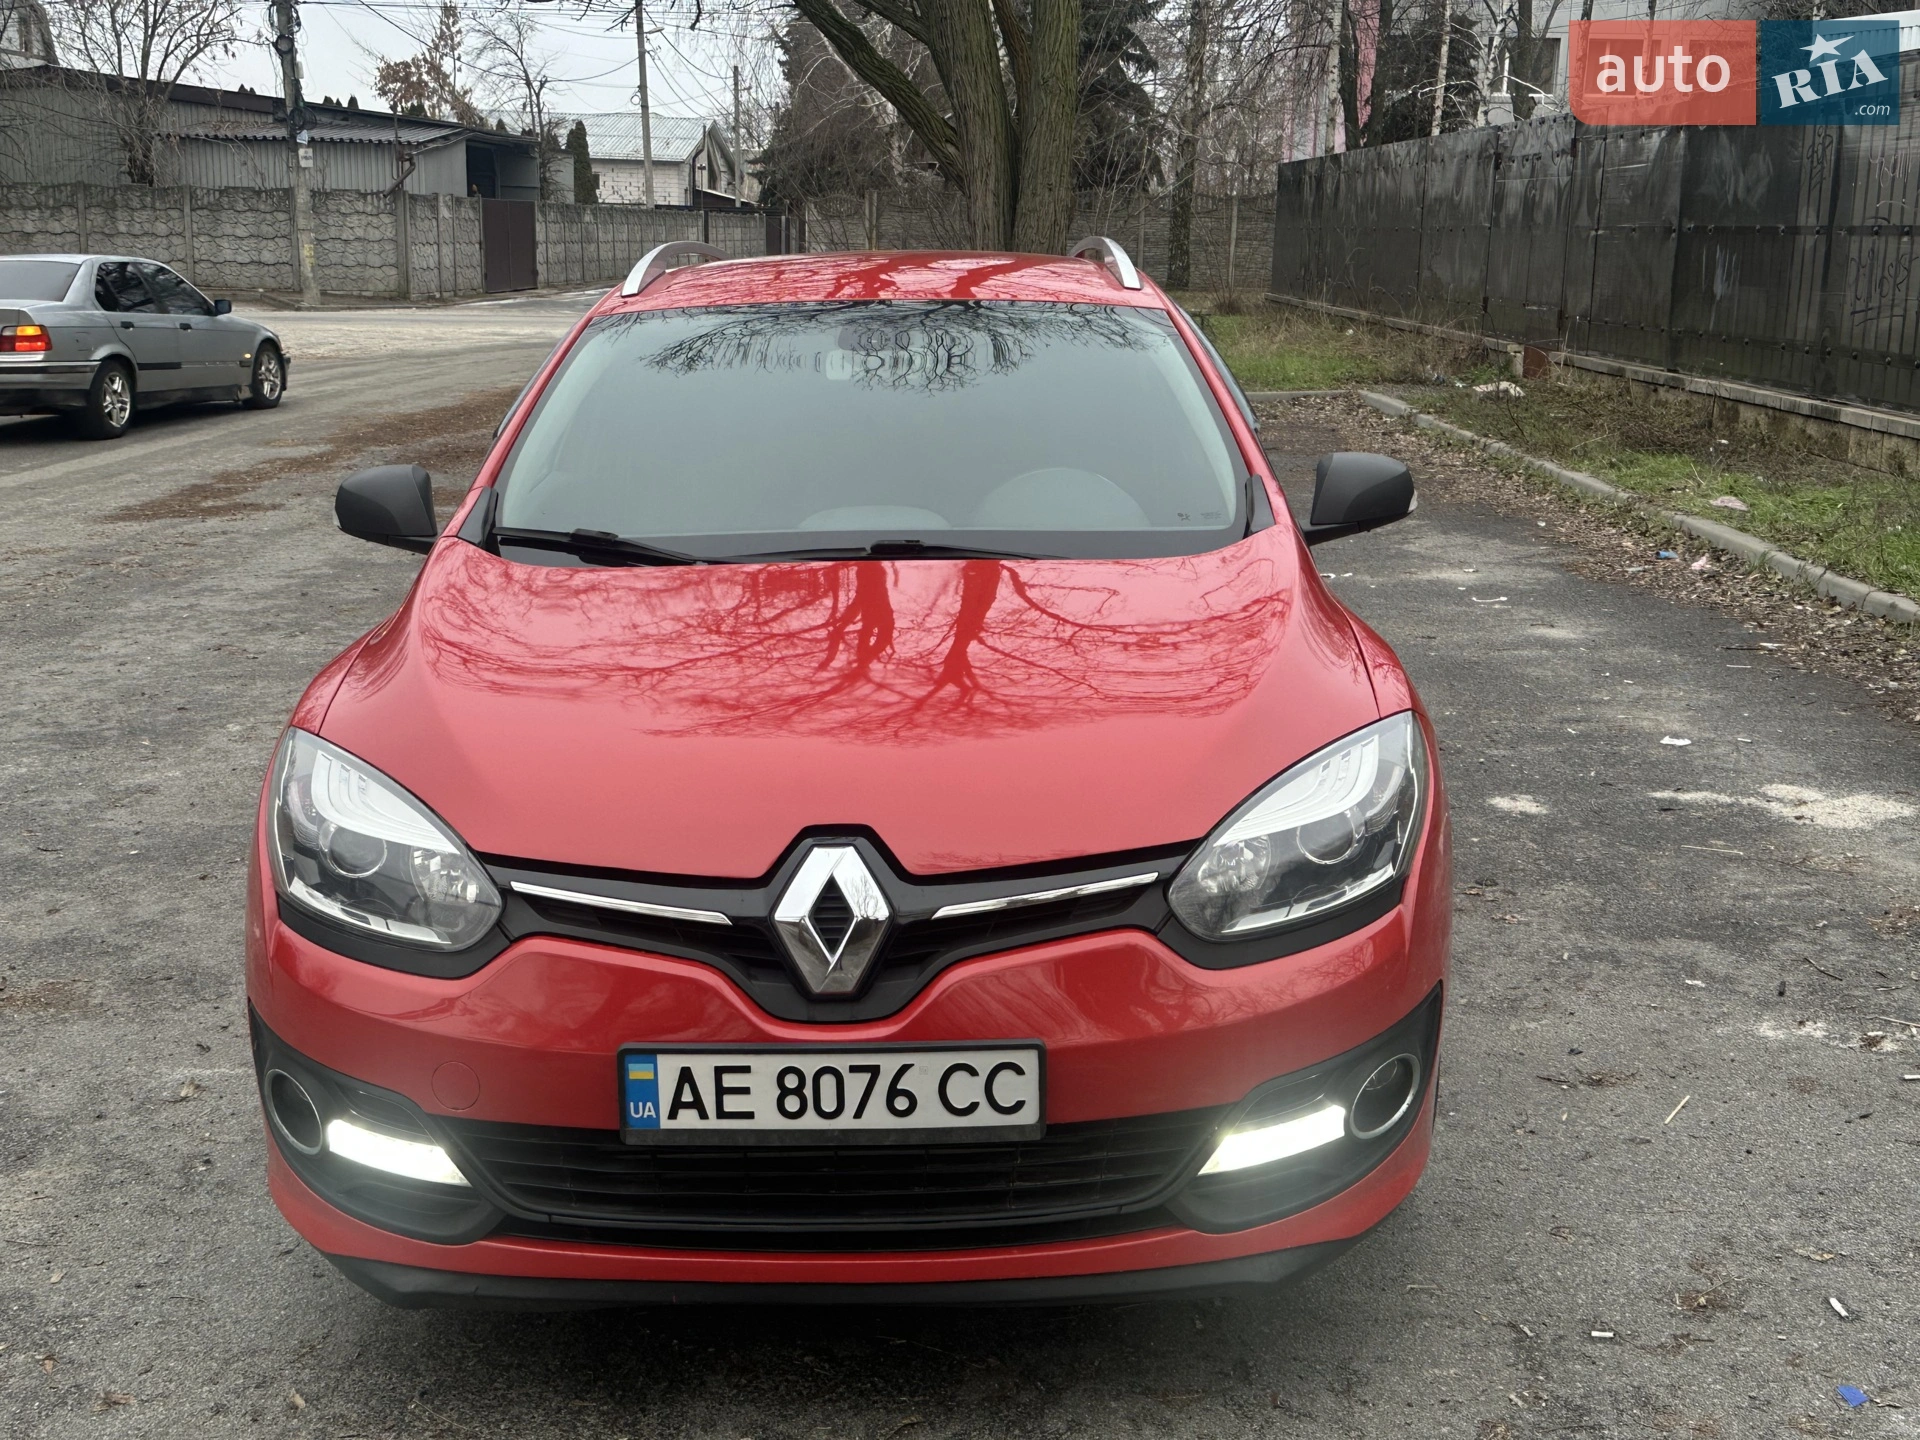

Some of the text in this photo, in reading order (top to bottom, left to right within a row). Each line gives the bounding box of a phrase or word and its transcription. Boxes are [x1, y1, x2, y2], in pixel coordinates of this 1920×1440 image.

[667, 1061, 1027, 1120] AE 8076 CC
[630, 1102, 656, 1119] UA
